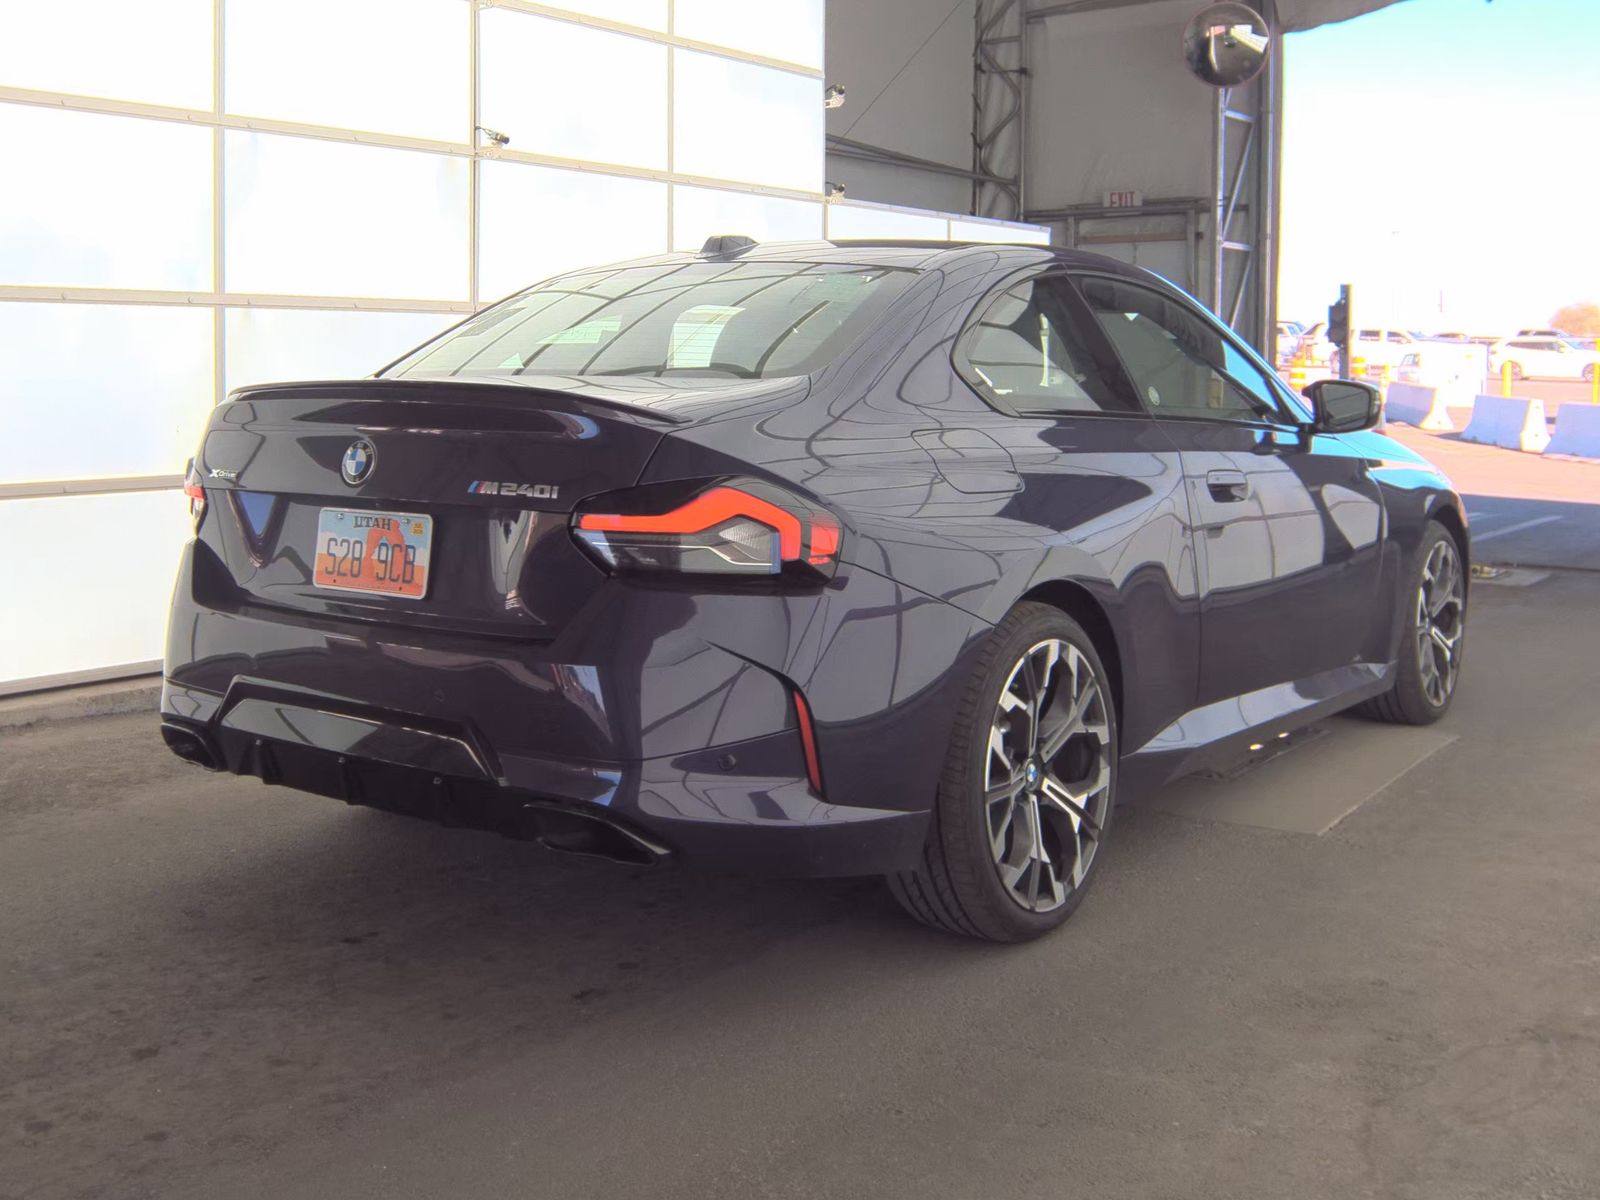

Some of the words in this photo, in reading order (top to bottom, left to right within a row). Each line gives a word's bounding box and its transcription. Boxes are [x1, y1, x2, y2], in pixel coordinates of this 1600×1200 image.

[1110, 191, 1136, 208] EXIT
[353, 515, 392, 530] UTAH
[325, 537, 363, 578] S28
[376, 542, 416, 584] 9CB
